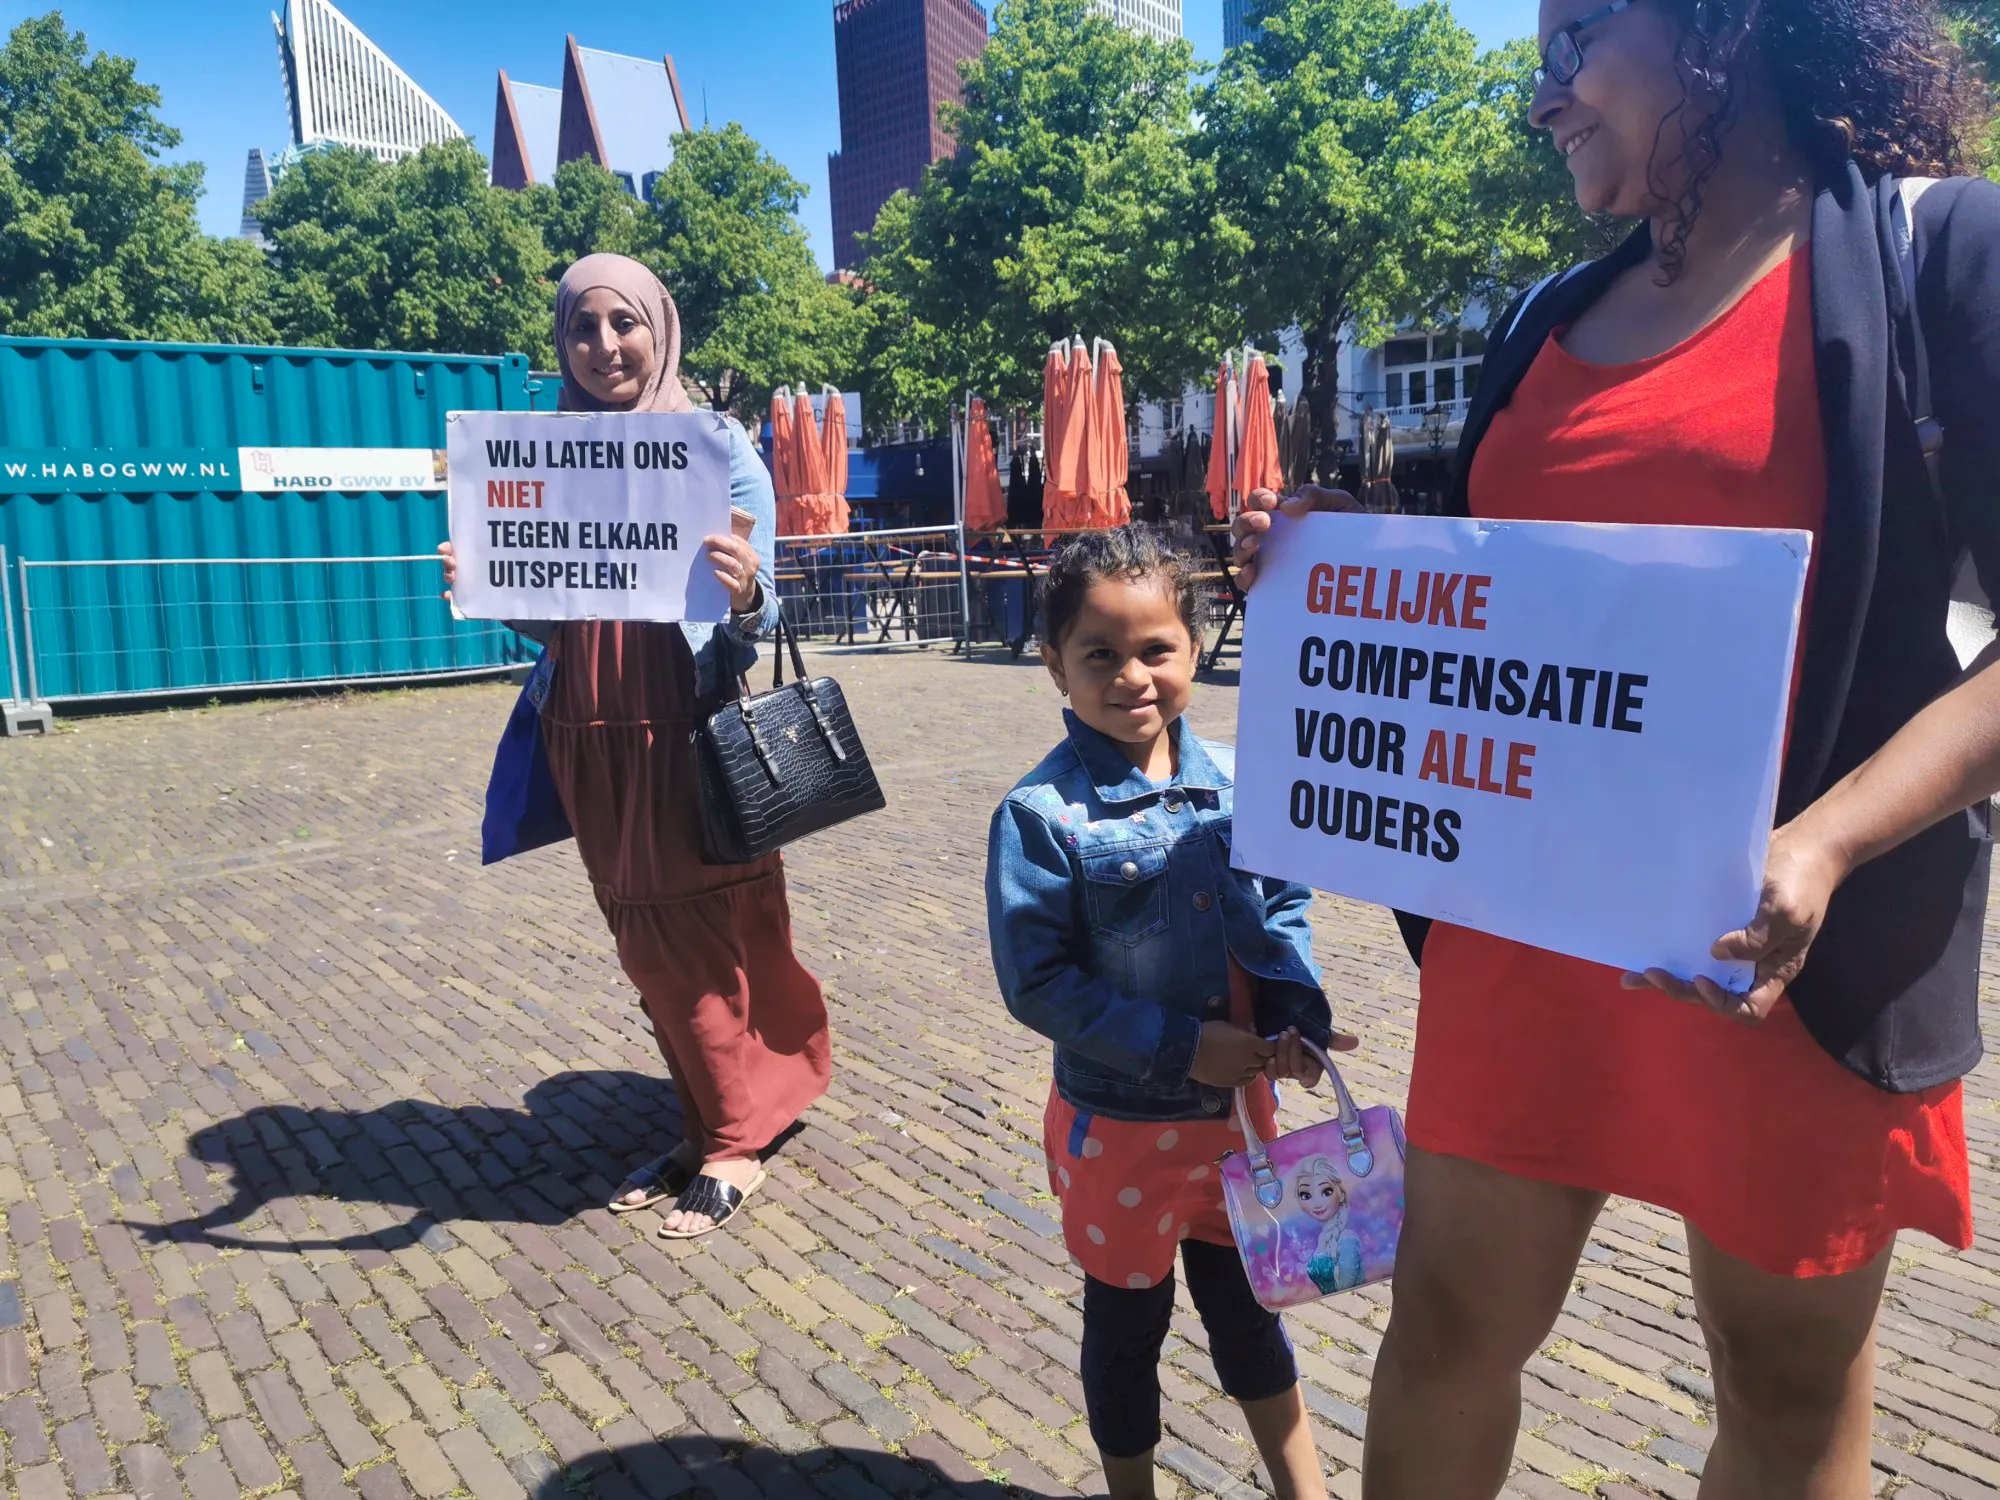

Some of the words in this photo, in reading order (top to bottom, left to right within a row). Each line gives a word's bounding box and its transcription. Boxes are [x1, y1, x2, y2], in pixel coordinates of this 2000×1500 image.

[4, 462, 231, 478] W.HABOGWW.NL
[485, 440, 537, 468] WIJ
[545, 440, 624, 470] LATEN
[633, 441, 688, 470] ONS
[273, 475, 333, 488] HABO
[339, 475, 393, 488] GWW
[399, 476, 426, 487] BV
[487, 480, 545, 509] NIET
[487, 520, 569, 549] TEGEN
[578, 521, 678, 551] ELKAAR
[489, 560, 637, 590] UITSPELEN!
[1306, 562, 1492, 631] GELIJKE
[1298, 635, 1649, 734] COMPENSATIE
[1294, 707, 1407, 776] VOOR
[1418, 729, 1537, 800] ALLE
[1289, 779, 1462, 863] OUDERS
